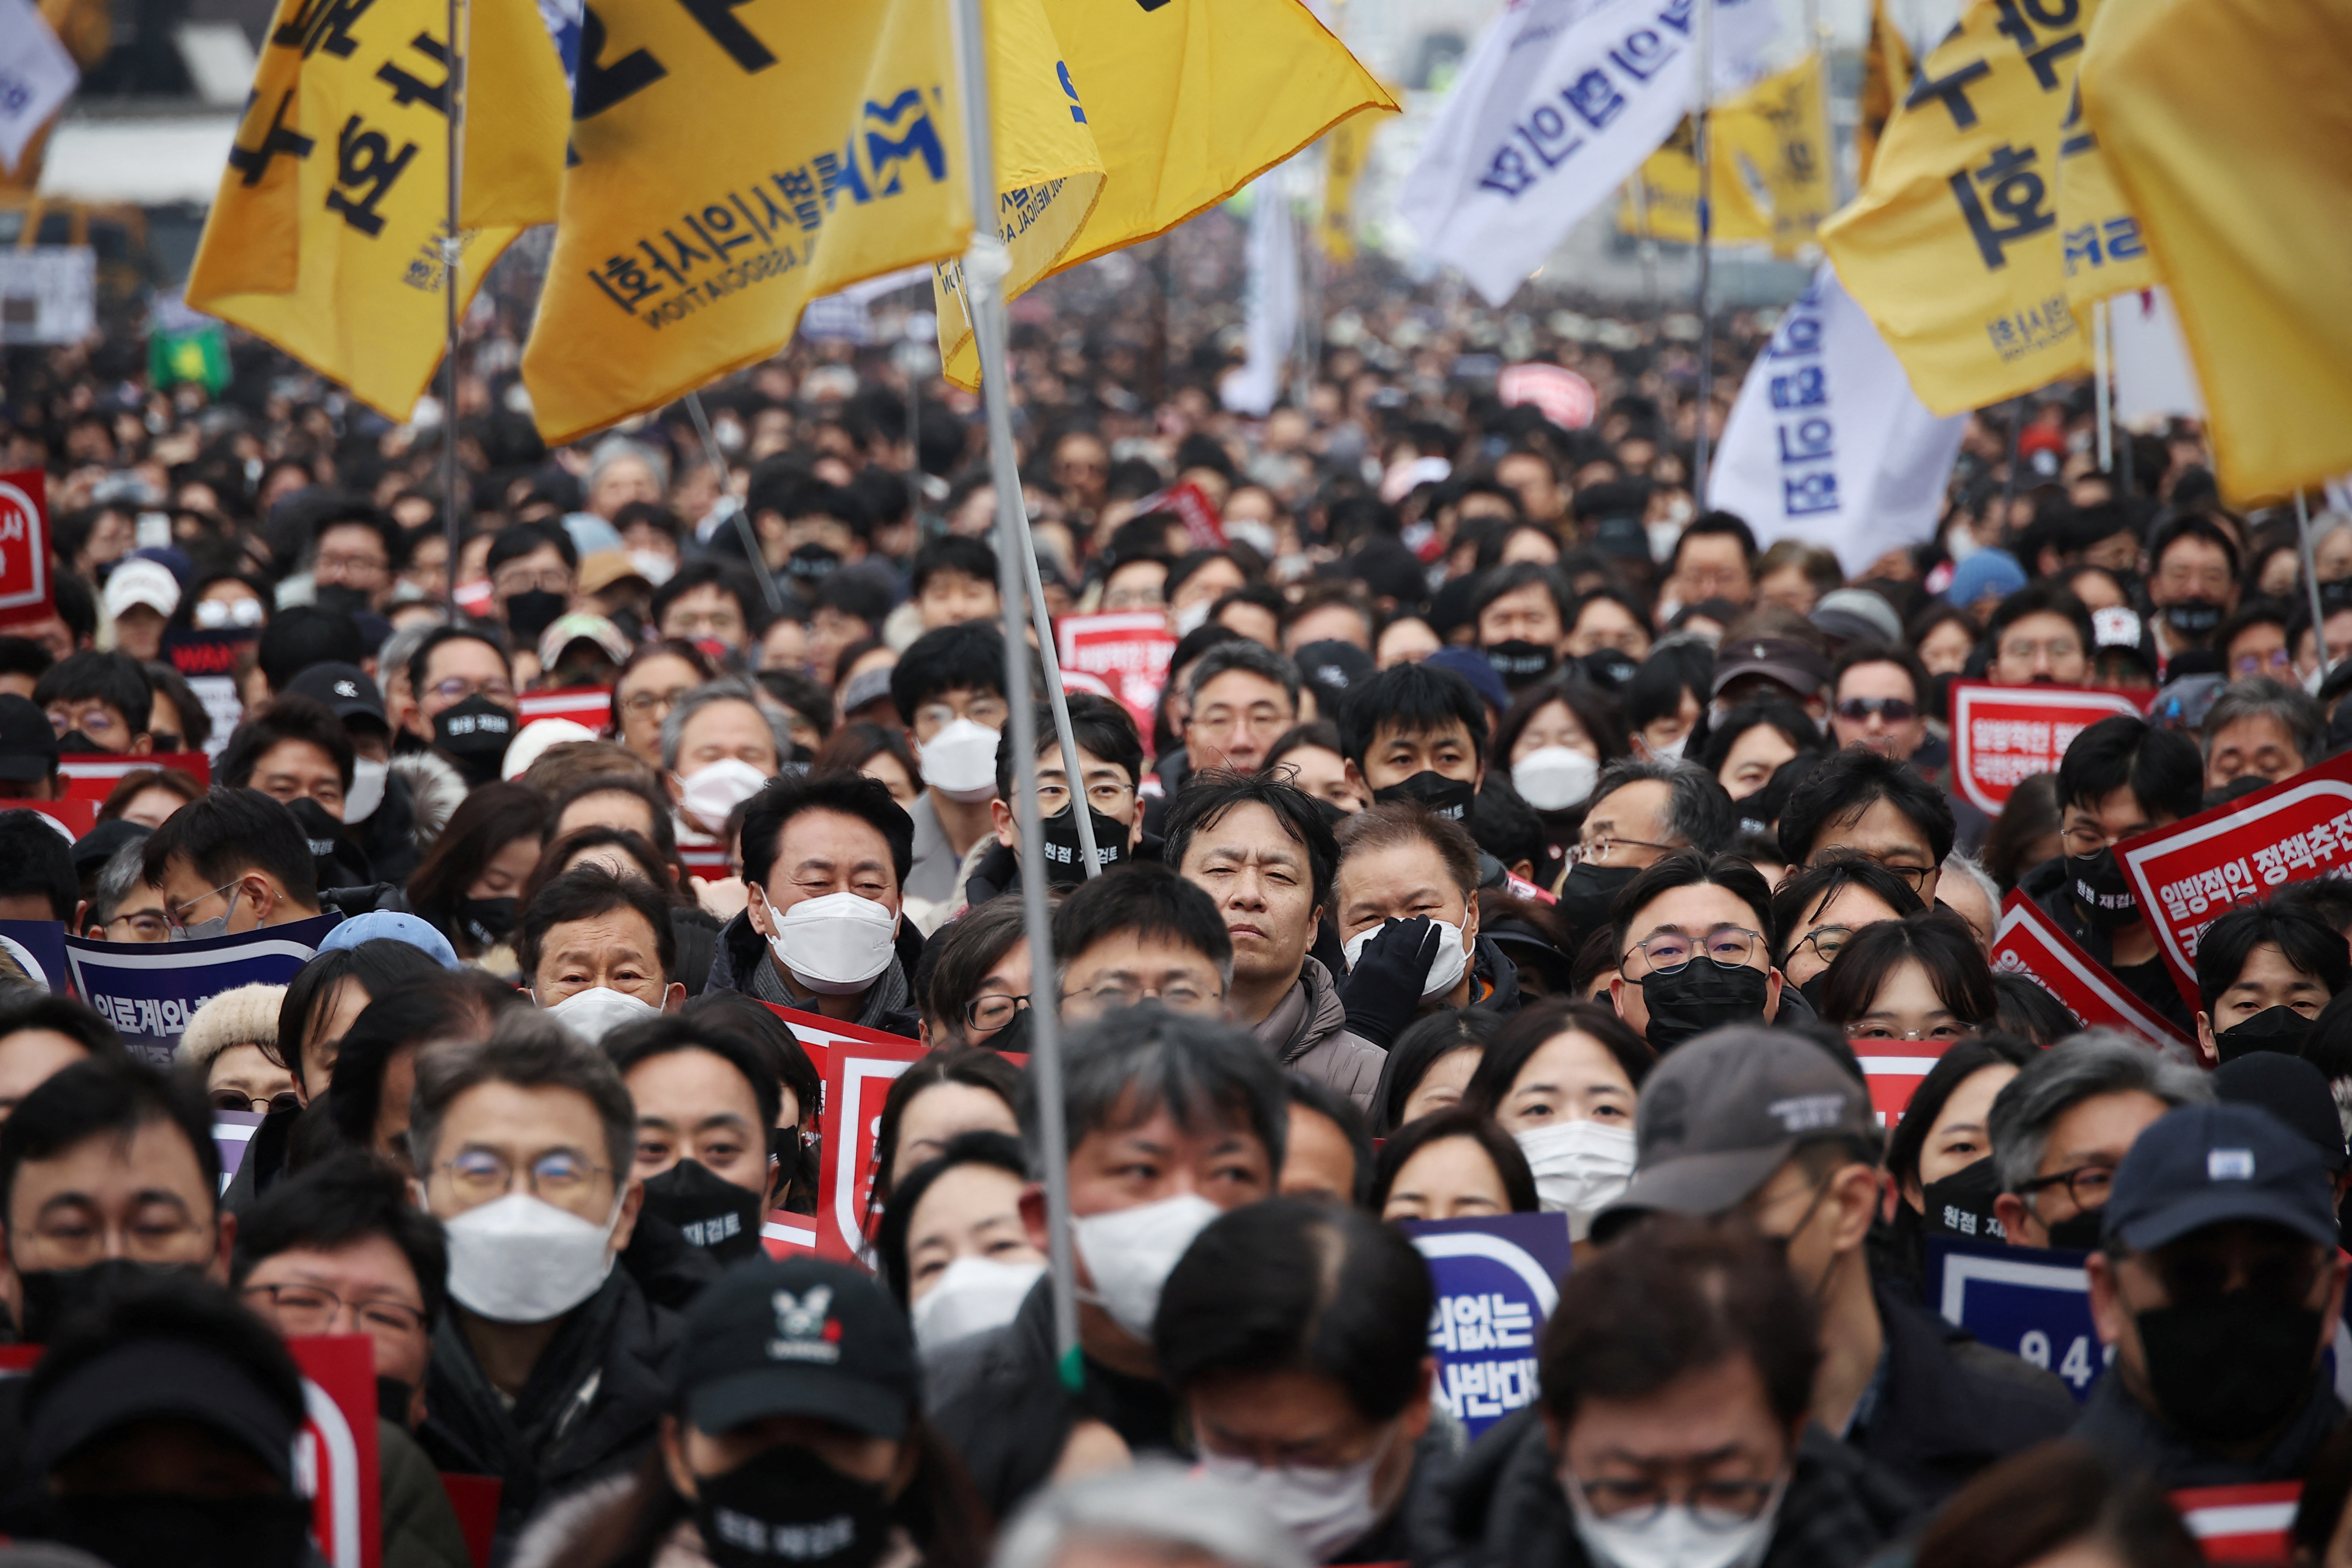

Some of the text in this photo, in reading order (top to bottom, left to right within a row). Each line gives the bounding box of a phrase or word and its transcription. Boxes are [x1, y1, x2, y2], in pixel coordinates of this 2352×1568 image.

[1044, 841, 1072, 864] 원점
[2160, 857, 2257, 921] 일방적인
[94, 994, 192, 1037] 의료계와
[1943, 1204, 1978, 1236] 원점
[1427, 1293, 1534, 1353] 의없는
[1430, 1358, 1542, 1418] 사반대
